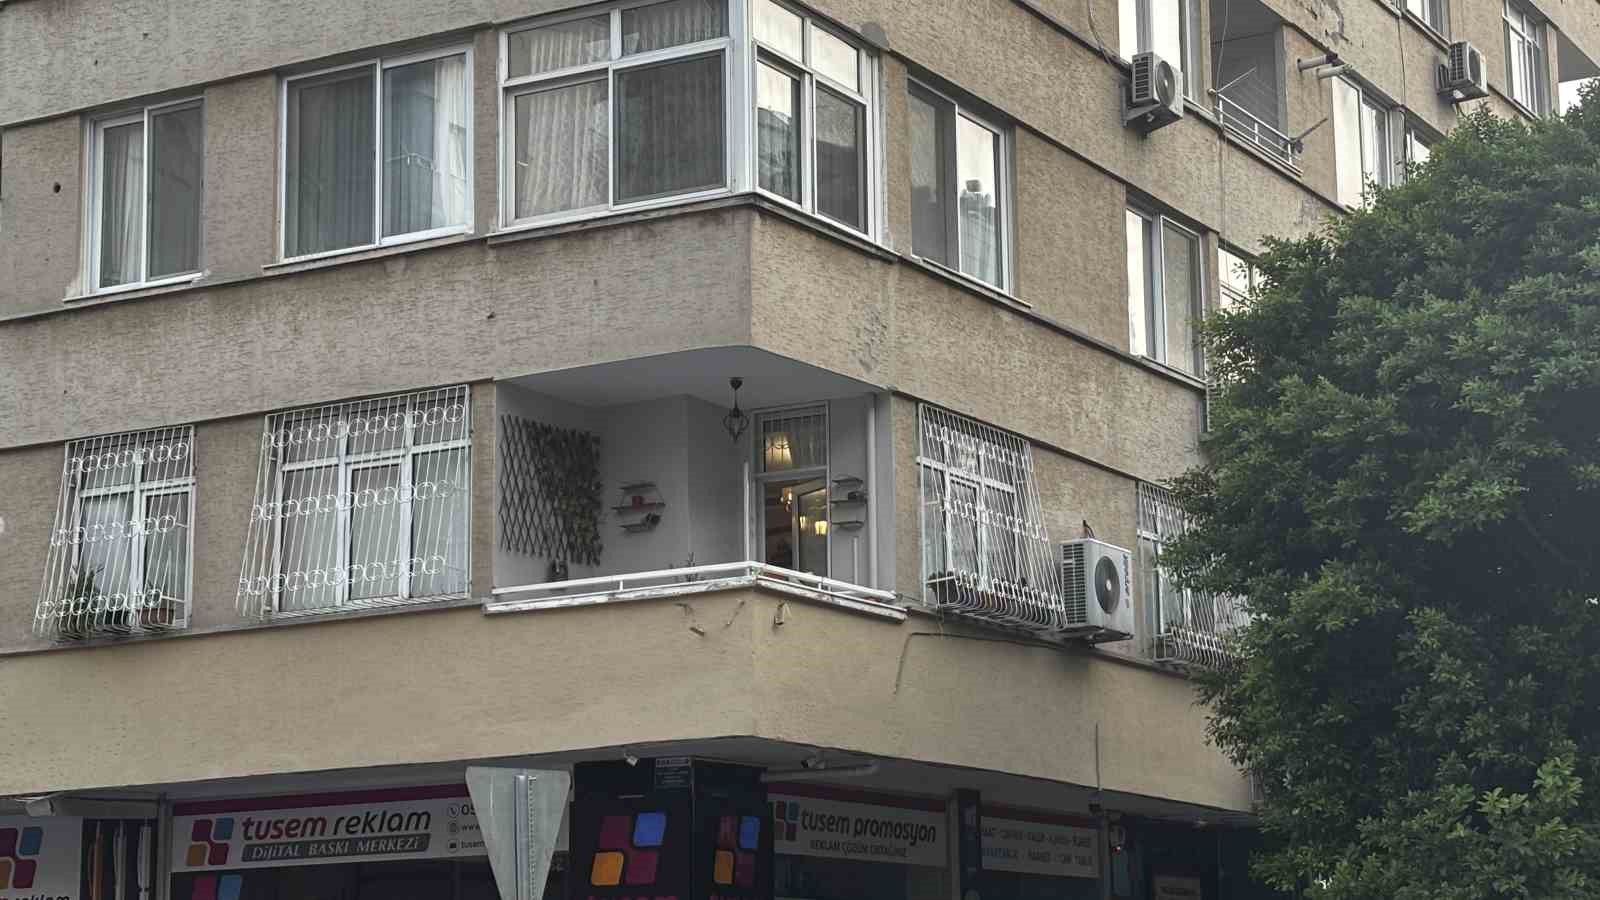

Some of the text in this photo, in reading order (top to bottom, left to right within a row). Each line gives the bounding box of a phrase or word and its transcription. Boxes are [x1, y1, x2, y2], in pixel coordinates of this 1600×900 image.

[242, 810, 431, 841] tusem reklam
[800, 809, 937, 847] tusem promosyon
